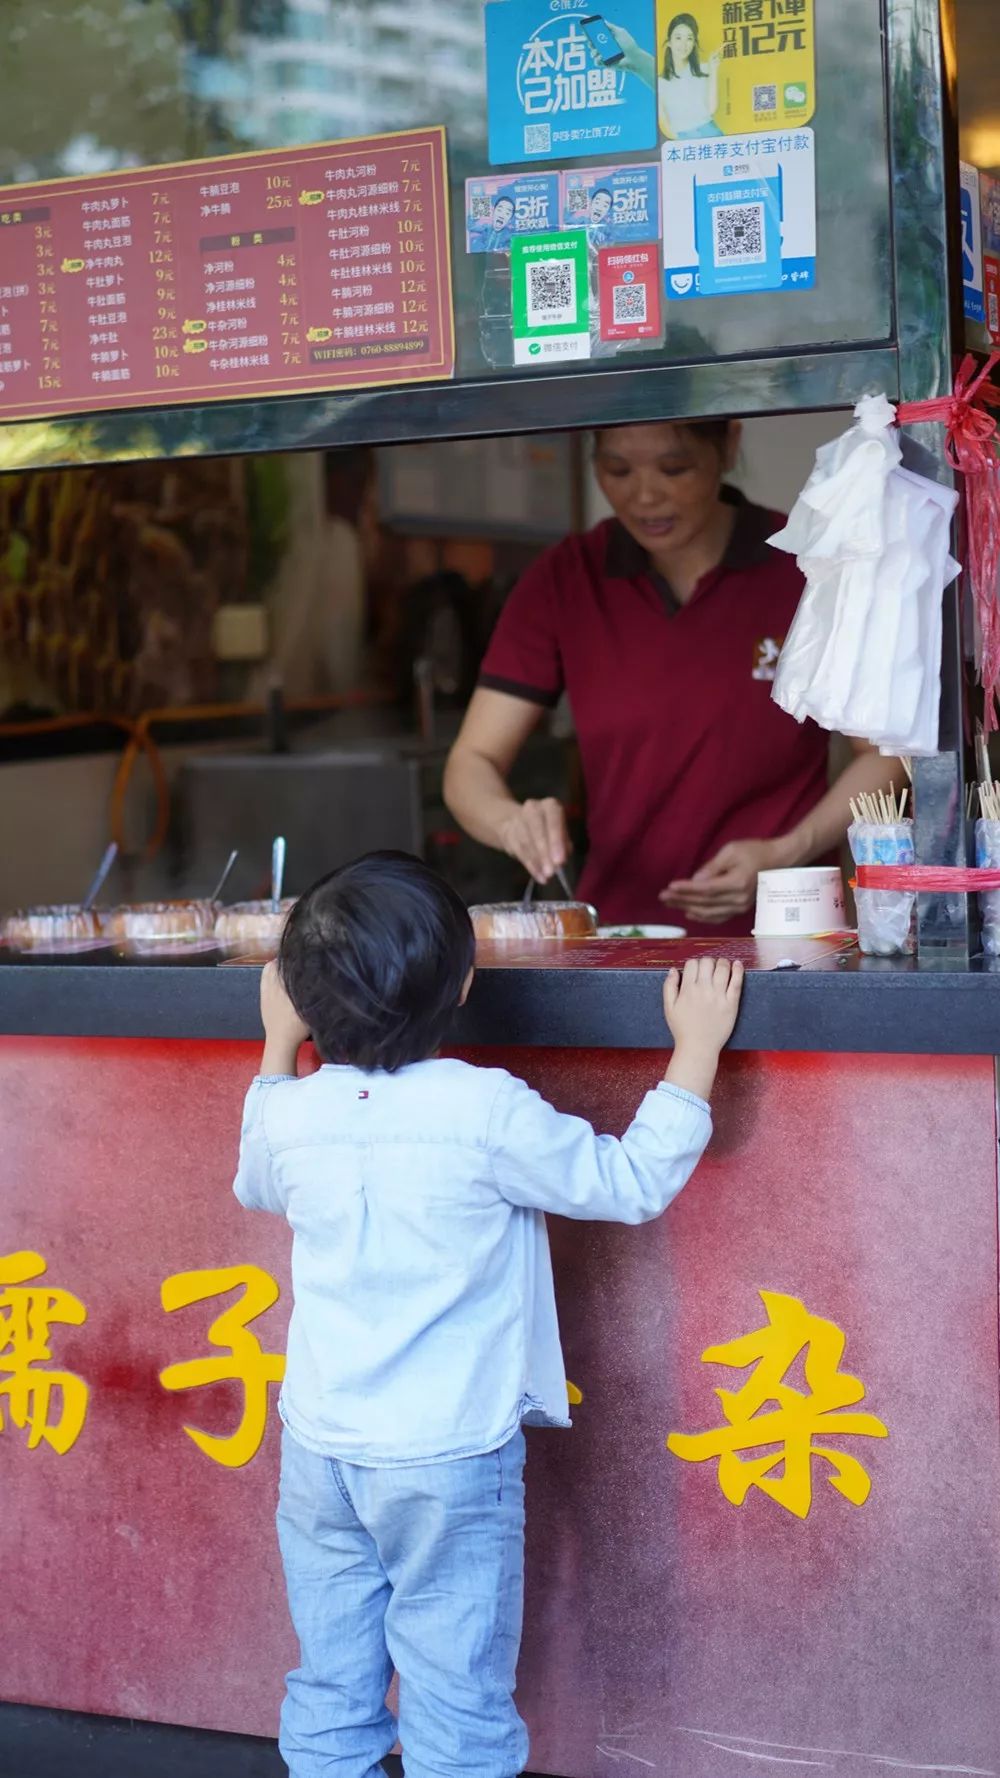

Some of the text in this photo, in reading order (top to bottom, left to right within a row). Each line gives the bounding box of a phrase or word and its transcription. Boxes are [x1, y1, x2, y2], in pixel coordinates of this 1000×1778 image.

[722, 0, 806, 24] 新客下单
[739, 19, 806, 56] 12元
[521, 23, 588, 76] 本店
[666, 134, 809, 162] 本店推荐支付宝付款
[325, 160, 420, 181] 牛肉丸河粉 7元
[266, 176, 291, 189] 10元
[326, 181, 399, 201] 牛肉丸河源细粉
[402, 180, 421, 192] 7元
[152, 192, 170, 205] 7元
[266, 196, 292, 209] 25元
[613, 187, 648, 211] 5折
[327, 200, 422, 221] 牛肉丸桂林米线 7元
[515, 196, 549, 219] 5折
[153, 211, 171, 224] 7元
[35, 226, 53, 239] 3元
[328, 220, 423, 240] 牛肚河粉 10元
[154, 231, 172, 243] 7元
[36, 244, 54, 257] 3元
[399, 240, 424, 253] 10元
[149, 250, 173, 263] 12元
[277, 254, 296, 267] 4元
[37, 263, 55, 276] 3元
[156, 269, 174, 281] 9元
[330, 260, 425, 280] 牛肚桂林米线 10元
[278, 274, 297, 286] 4元
[401, 280, 426, 293] 12元
[38, 282, 56, 295] 3元
[157, 288, 175, 300] 9元
[40, 301, 57, 314] 7元
[206, 293, 298, 314] 净桂林米线 4元
[402, 299, 428, 313] 12元
[158, 307, 176, 320] 9元
[280, 313, 299, 325] 7元
[40, 319, 58, 333] 7元
[403, 319, 428, 334] 12元
[152, 326, 177, 340] 23元
[281, 332, 300, 344] 7元
[42, 338, 60, 351] 7元
[155, 346, 179, 359] 10元
[43, 357, 61, 370] 7元
[209, 352, 301, 370] 牛杂桂林米线 7元
[156, 364, 180, 378] 10元
[38, 375, 62, 389] 15元
